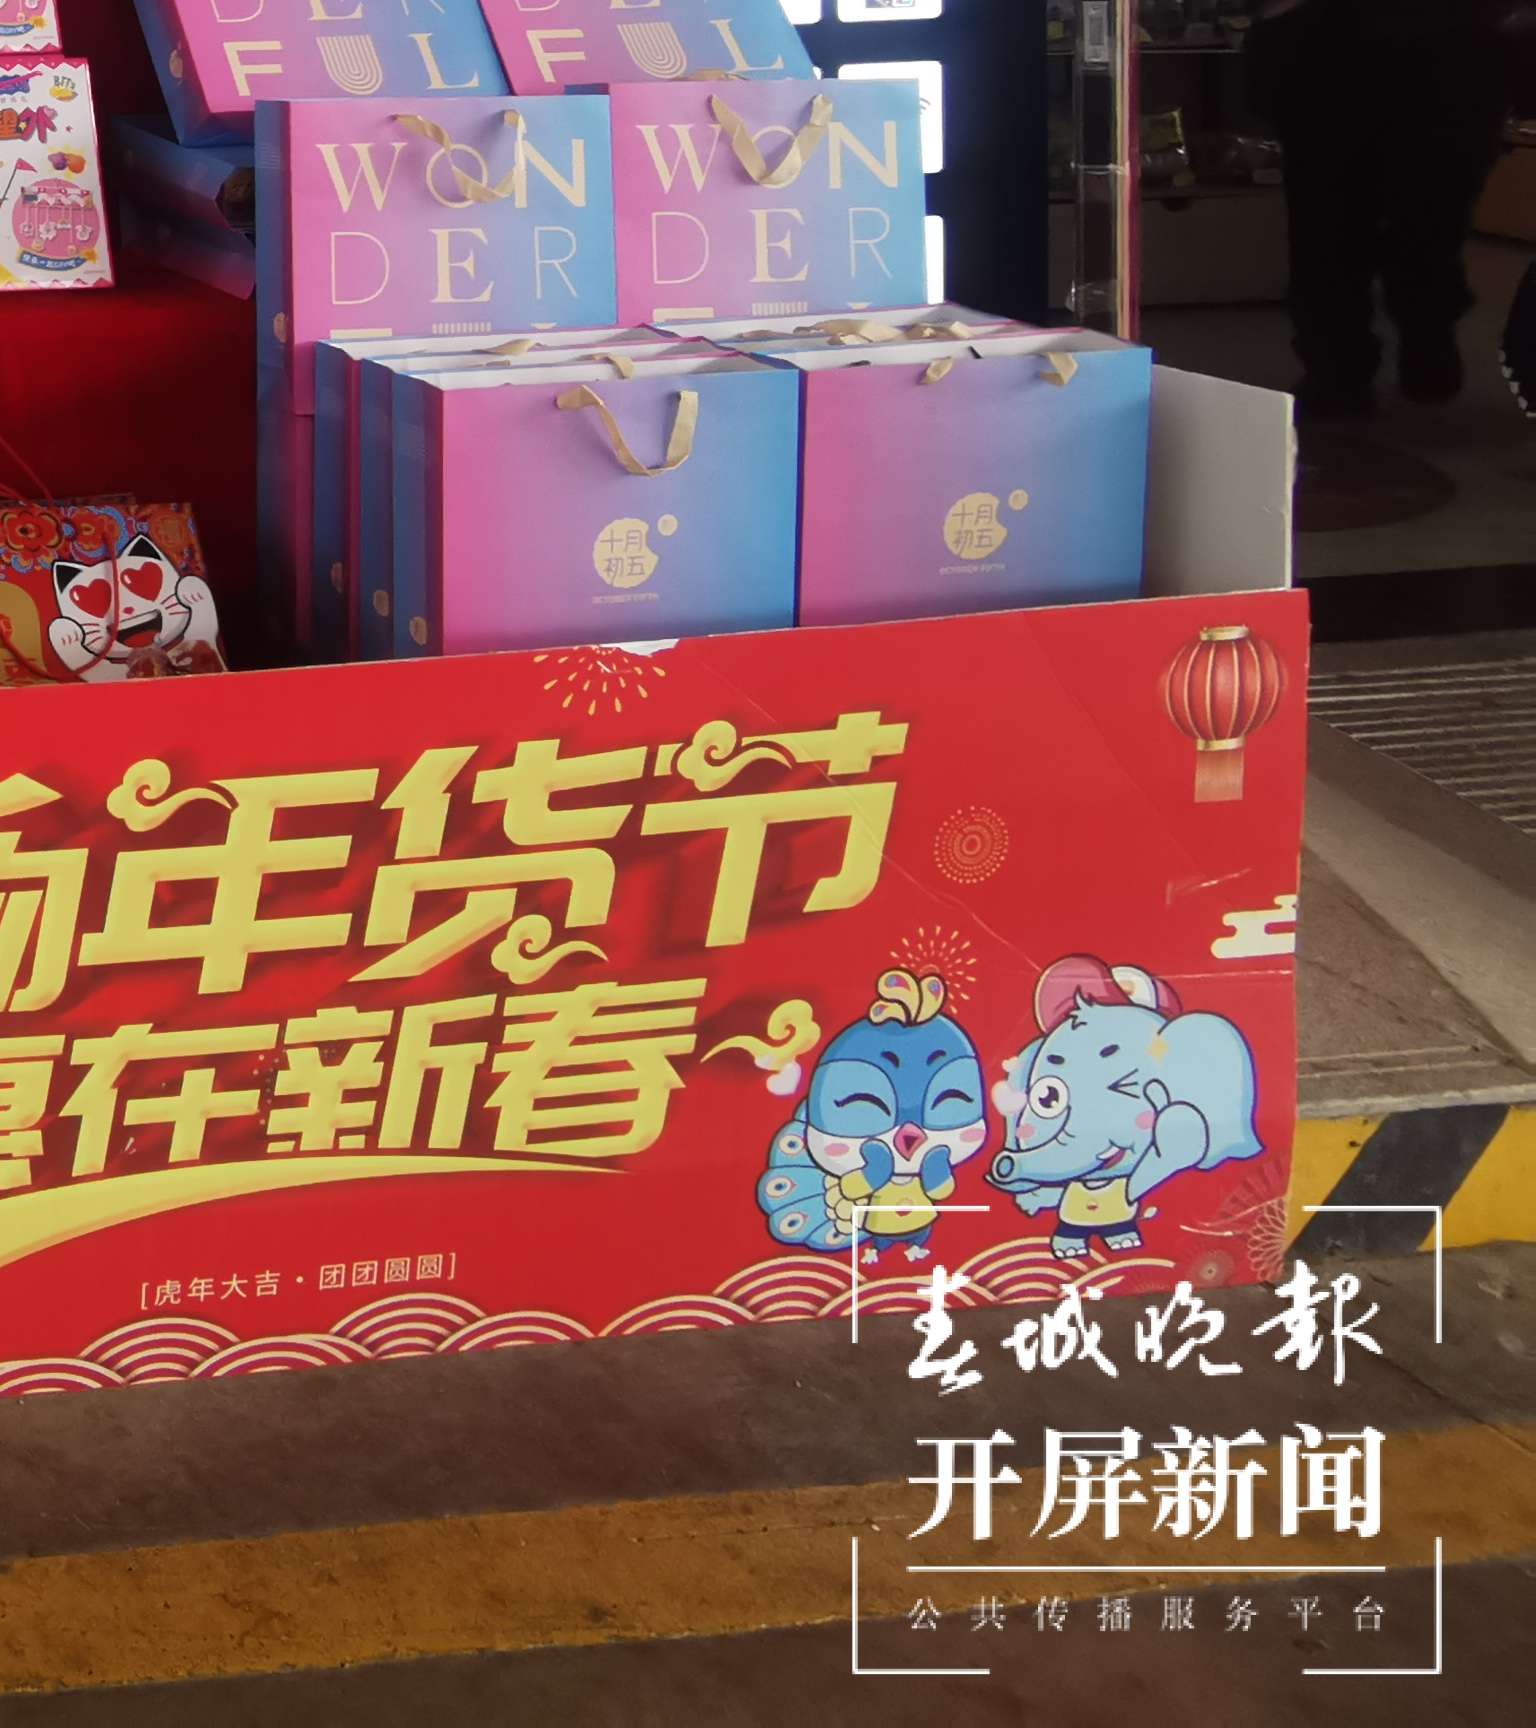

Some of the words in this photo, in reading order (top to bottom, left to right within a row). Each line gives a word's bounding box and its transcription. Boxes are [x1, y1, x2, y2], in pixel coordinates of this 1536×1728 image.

[223, 32, 480, 97] FUL
[525, 18, 785, 83] FUL
[315, 138, 587, 213] WON
[329, 226, 579, 305] DER
[652, 207, 892, 285] DER
[599, 528, 644, 553] 十月
[951, 502, 993, 526] 十月
[954, 529, 993, 554] 初五
[603, 555, 646, 584] 初五
